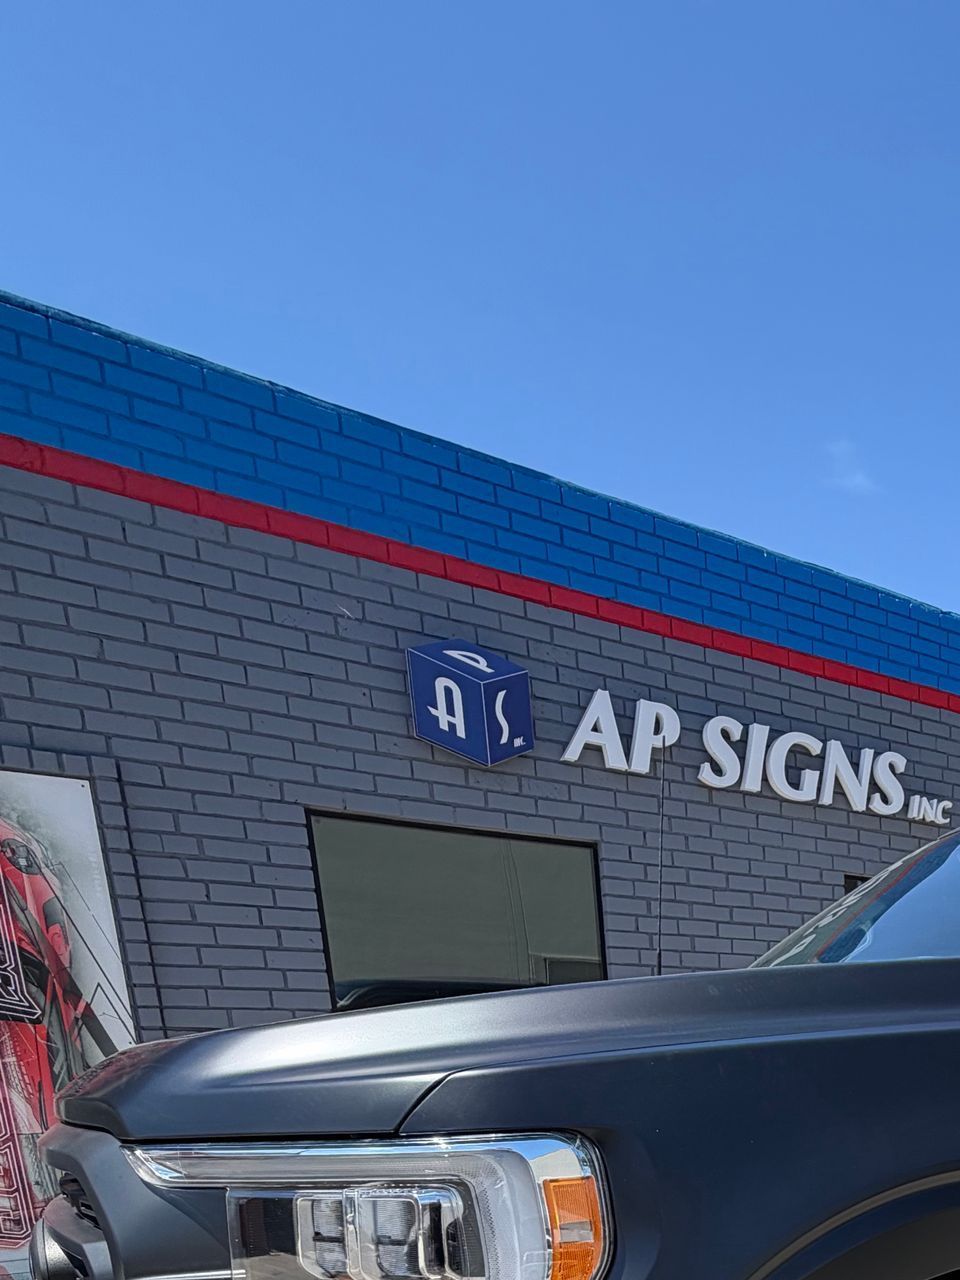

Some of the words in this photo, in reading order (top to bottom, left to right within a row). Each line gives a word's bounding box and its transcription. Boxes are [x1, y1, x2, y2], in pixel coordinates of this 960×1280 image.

[560, 688, 681, 774] AP
[697, 715, 907, 816] SIGNS
[907, 795, 953, 825] INC
